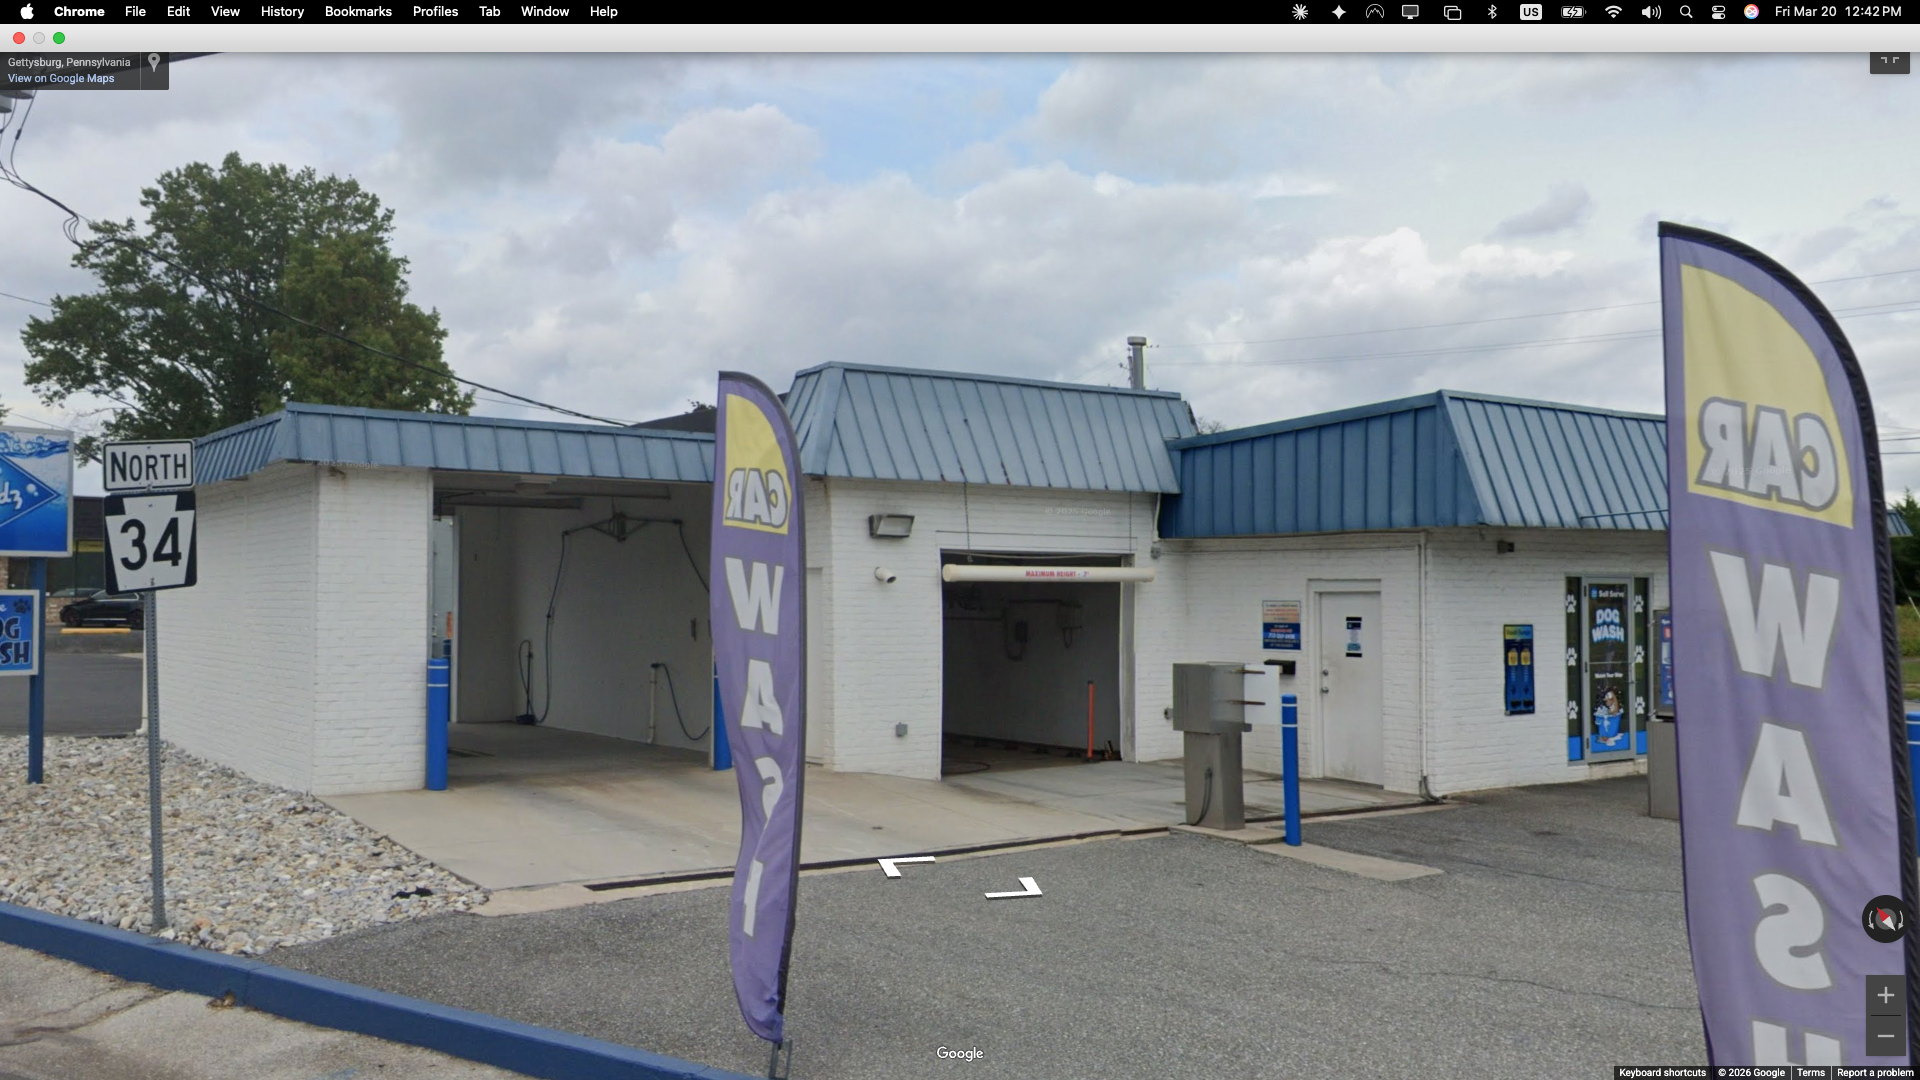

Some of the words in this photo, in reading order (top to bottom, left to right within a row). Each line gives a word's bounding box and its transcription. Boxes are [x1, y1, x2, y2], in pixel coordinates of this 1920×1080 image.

[111, 452, 187, 482] NORTH
[120, 517, 182, 571] 34
[1596, 607, 1620, 624] DOG
[1591, 624, 1625, 642] WASH
